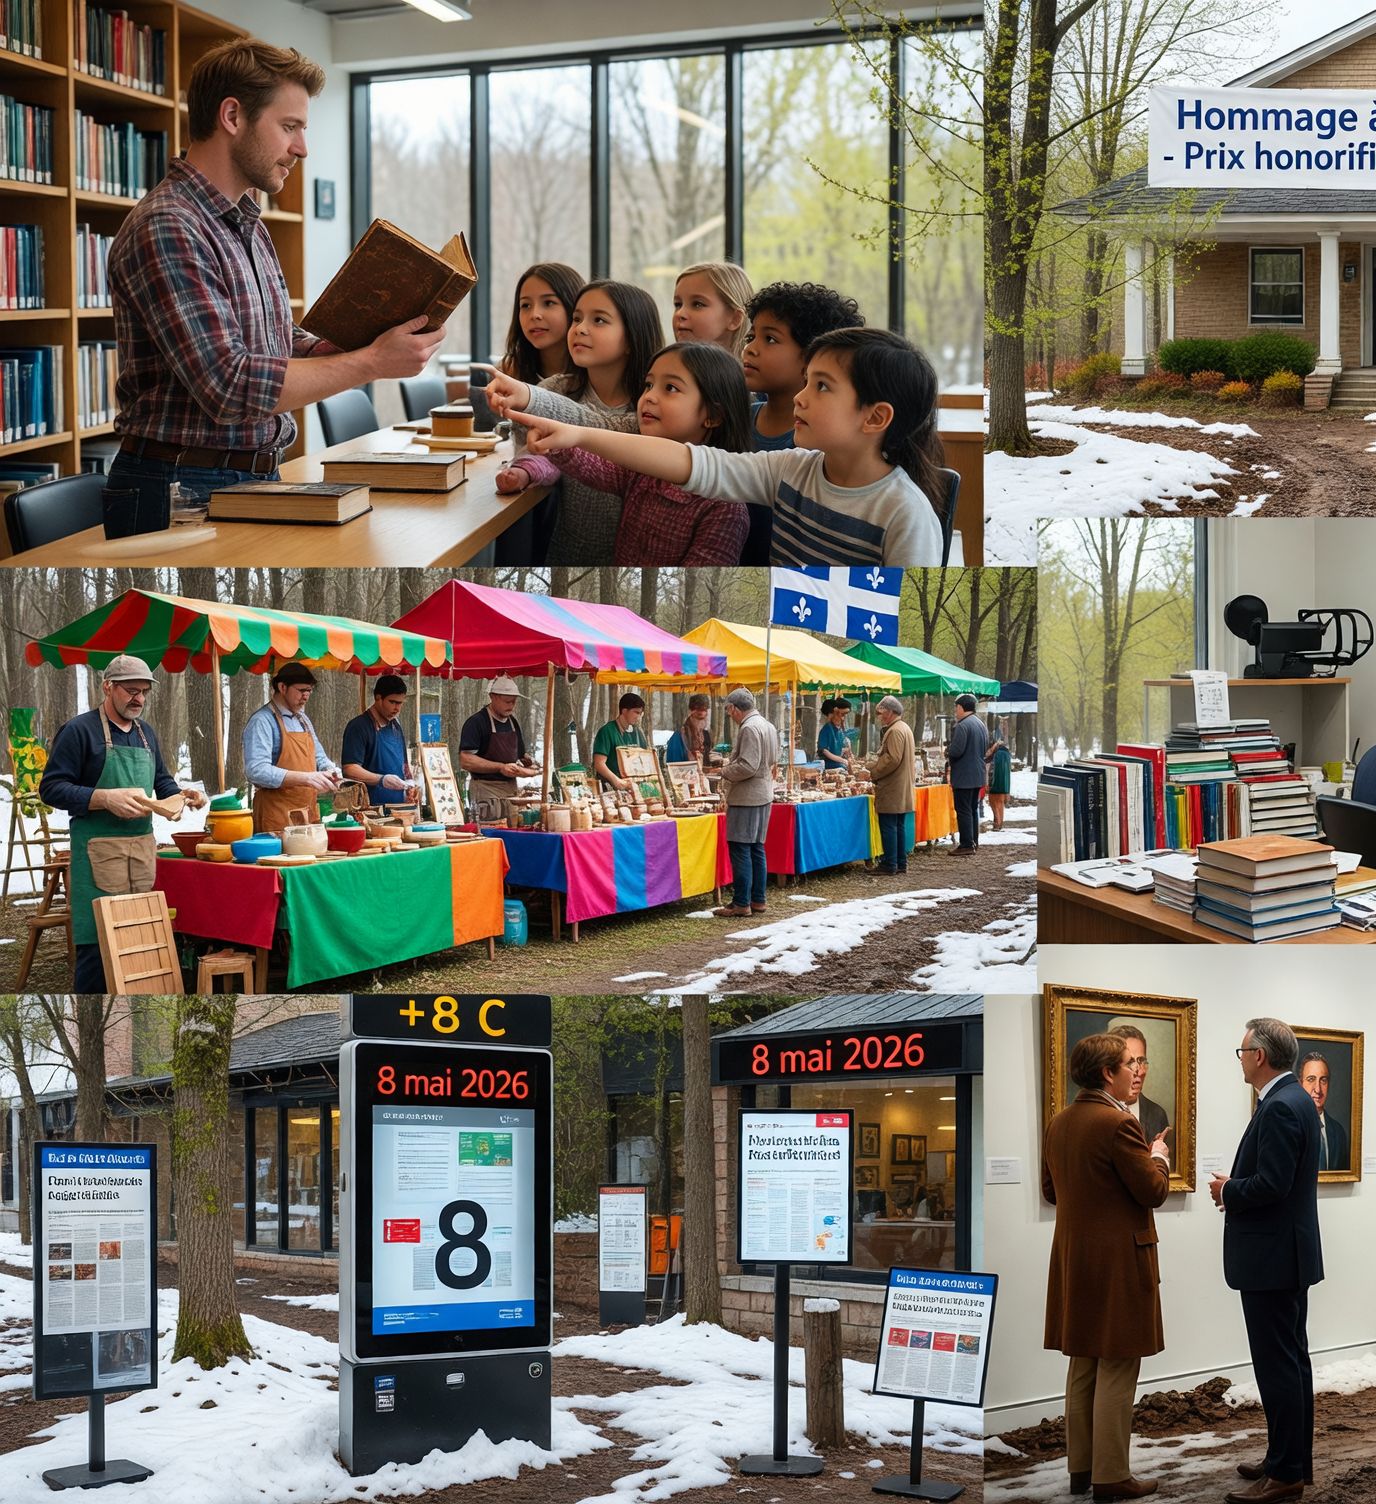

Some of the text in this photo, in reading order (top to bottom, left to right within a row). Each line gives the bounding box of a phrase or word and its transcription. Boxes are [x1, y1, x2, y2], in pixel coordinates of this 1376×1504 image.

[1177, 99, 1358, 140] Hommage
[1185, 141, 1245, 170] Prix
[399, 995, 506, 1037] +8 C
[751, 1033, 925, 1076] 8 mai 2026
[377, 1065, 529, 1100] 8 mai 2026
[435, 1199, 492, 1290] 8
